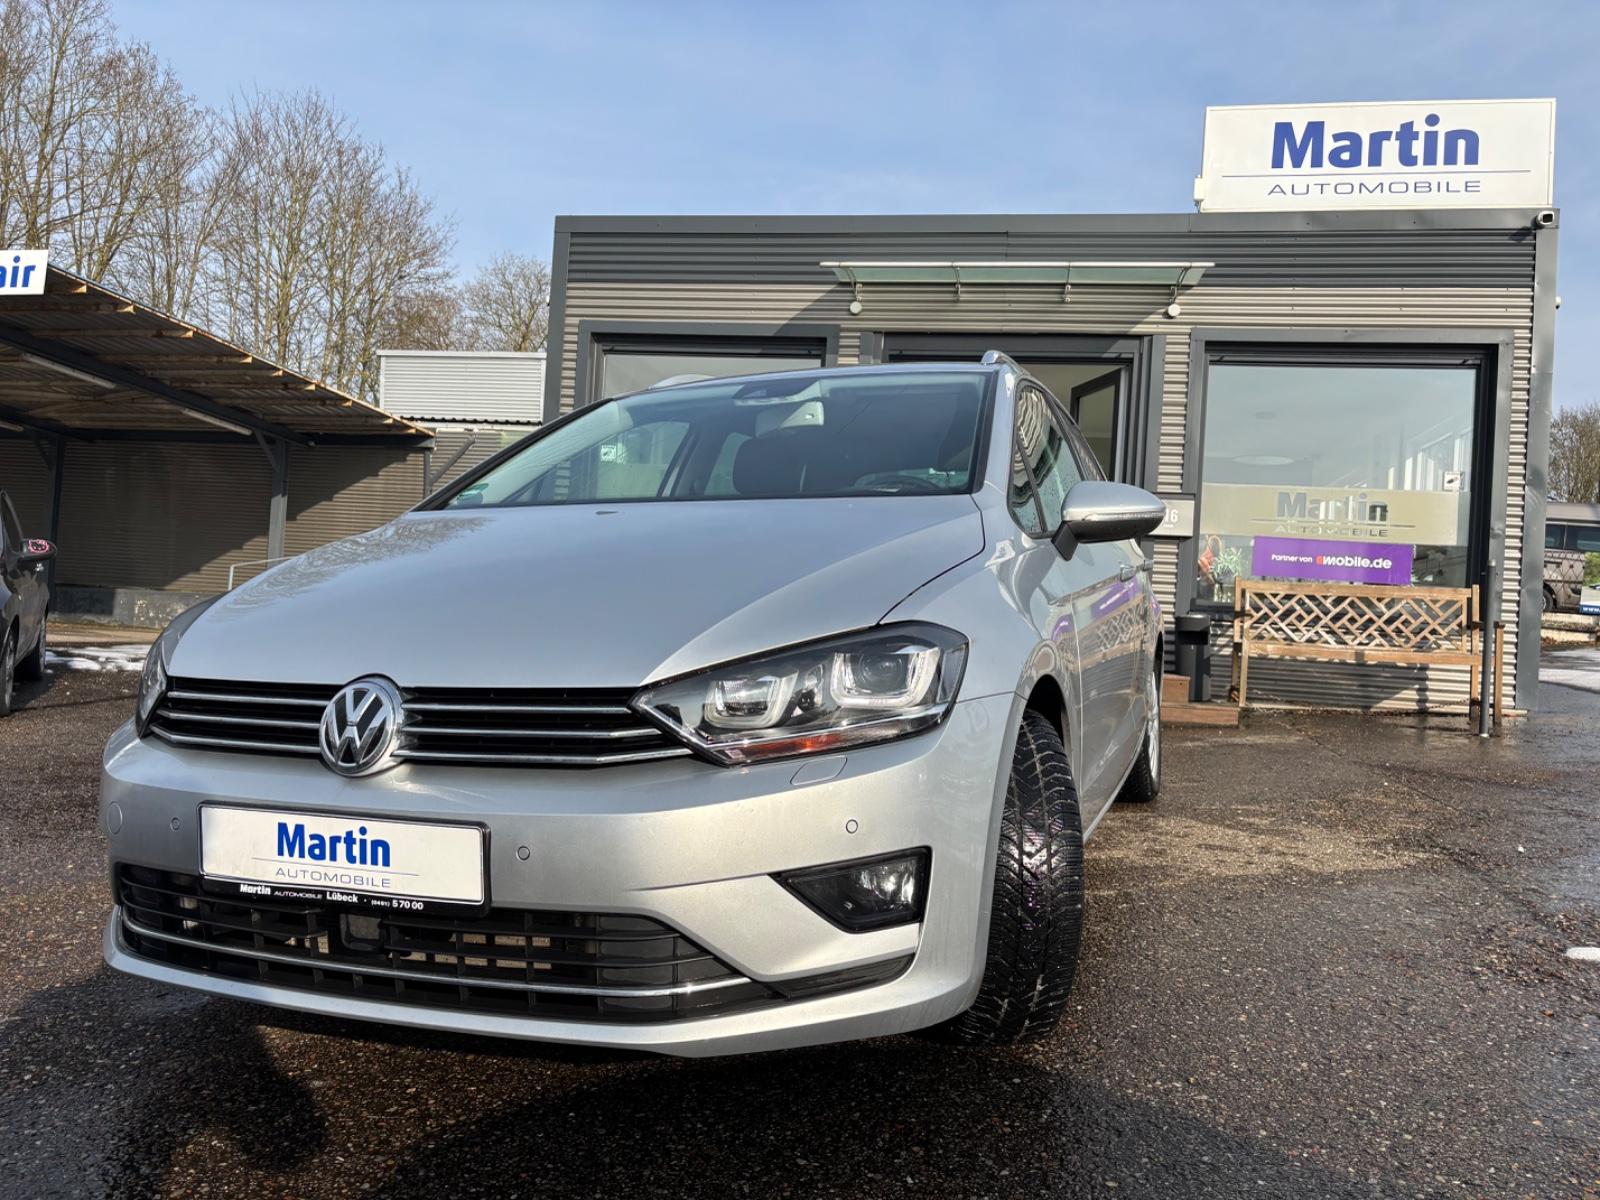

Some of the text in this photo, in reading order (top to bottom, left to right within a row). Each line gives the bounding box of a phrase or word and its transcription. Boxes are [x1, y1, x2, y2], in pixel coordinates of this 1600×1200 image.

[1271, 113, 1479, 169] Martin
[1268, 180, 1481, 196] AUTOMOBILE
[1277, 492, 1388, 521] Martin
[1271, 554, 1298, 562] Partner
[277, 822, 391, 868] Martin
[275, 867, 392, 889] AUTOMOBILE
[240, 884, 271, 896] Martin
[273, 890, 323, 899] AUTOMOBILE
[326, 891, 359, 904] Lübeck
